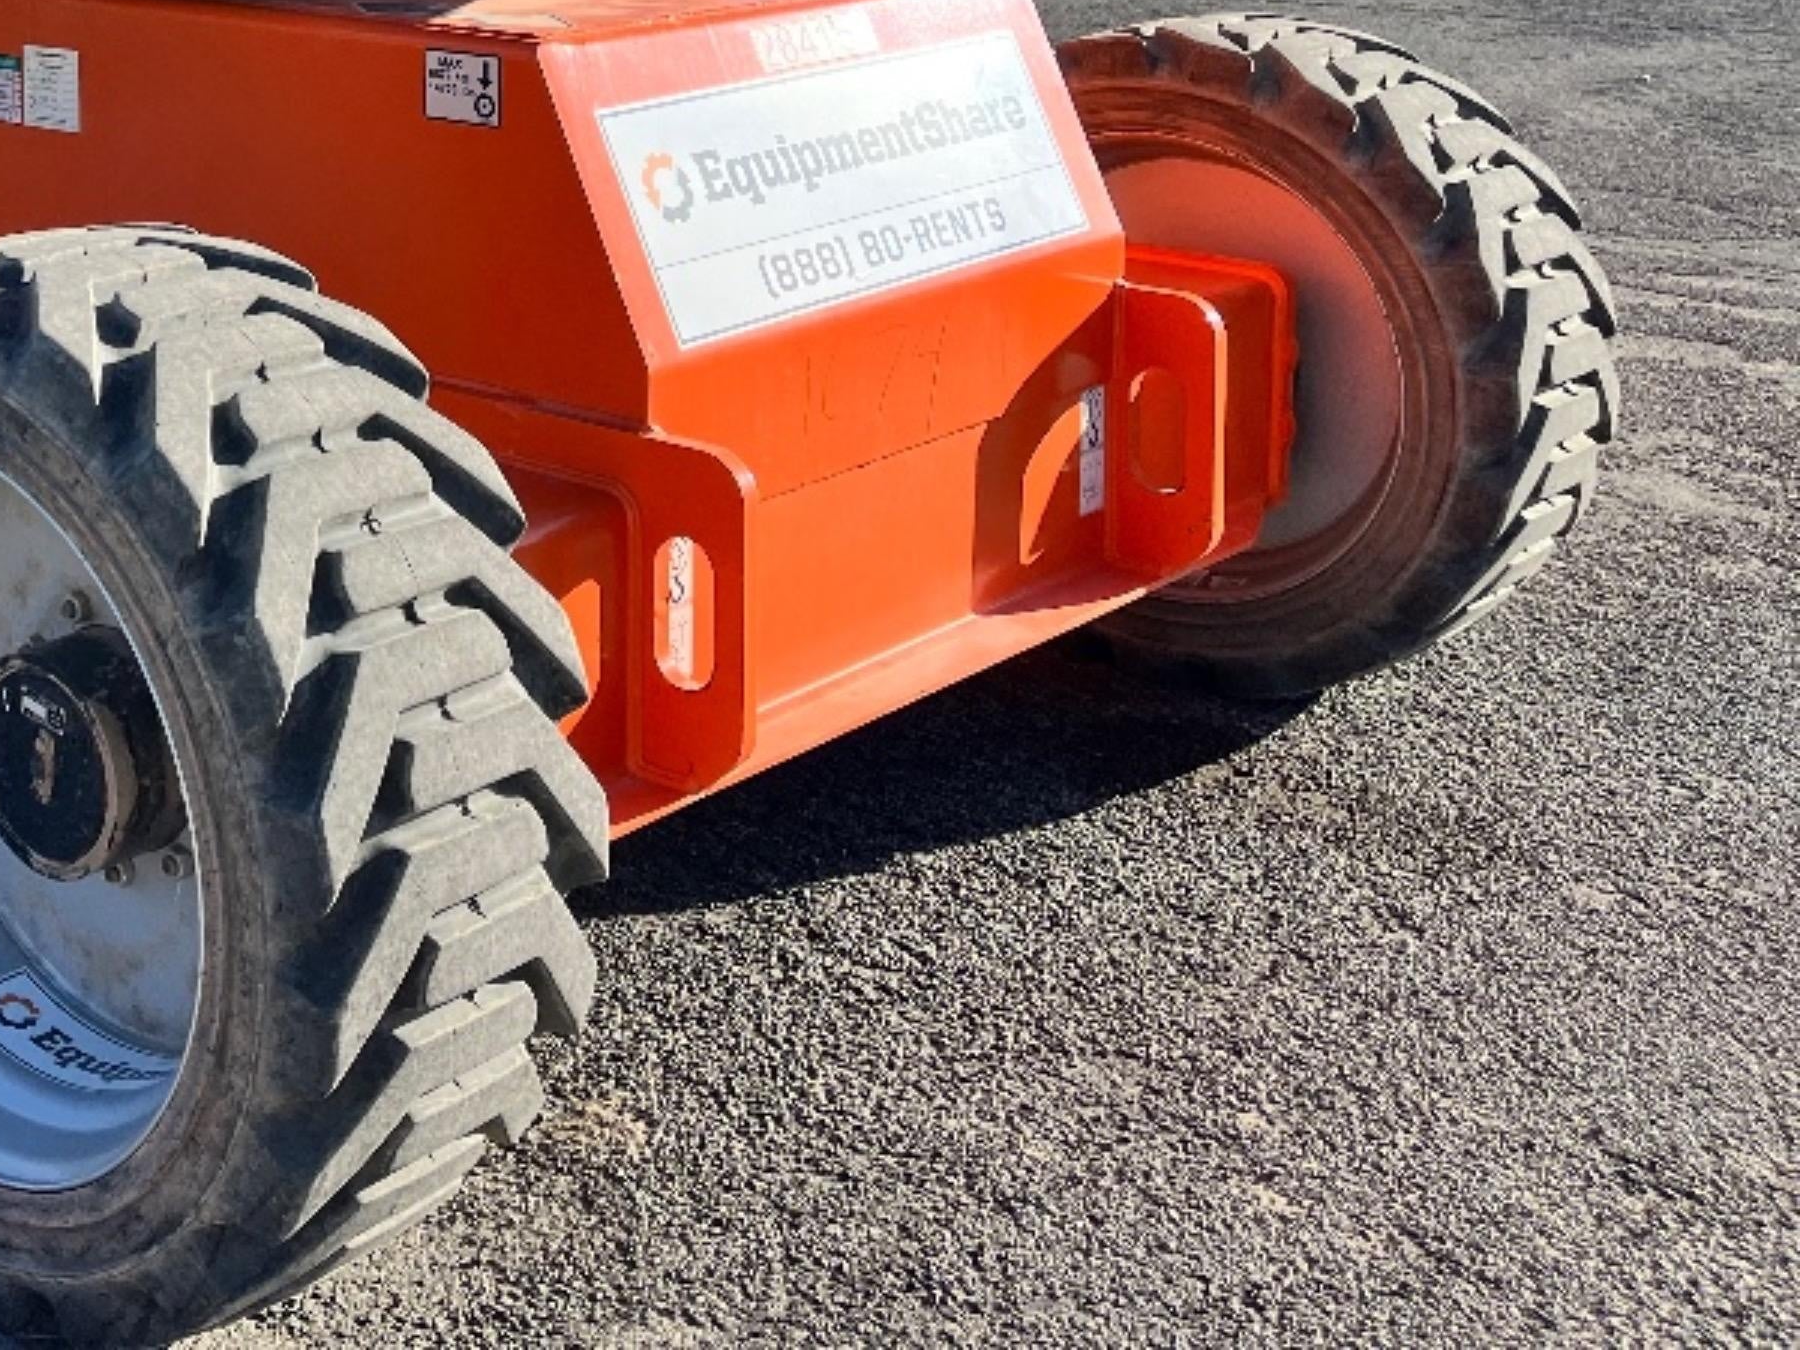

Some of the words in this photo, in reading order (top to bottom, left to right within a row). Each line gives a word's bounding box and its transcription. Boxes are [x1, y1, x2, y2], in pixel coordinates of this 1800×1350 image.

[691, 93, 1029, 206] EquipmentShare
[757, 234, 854, 299] (888)
[856, 196, 1008, 268] 80-RENTS
